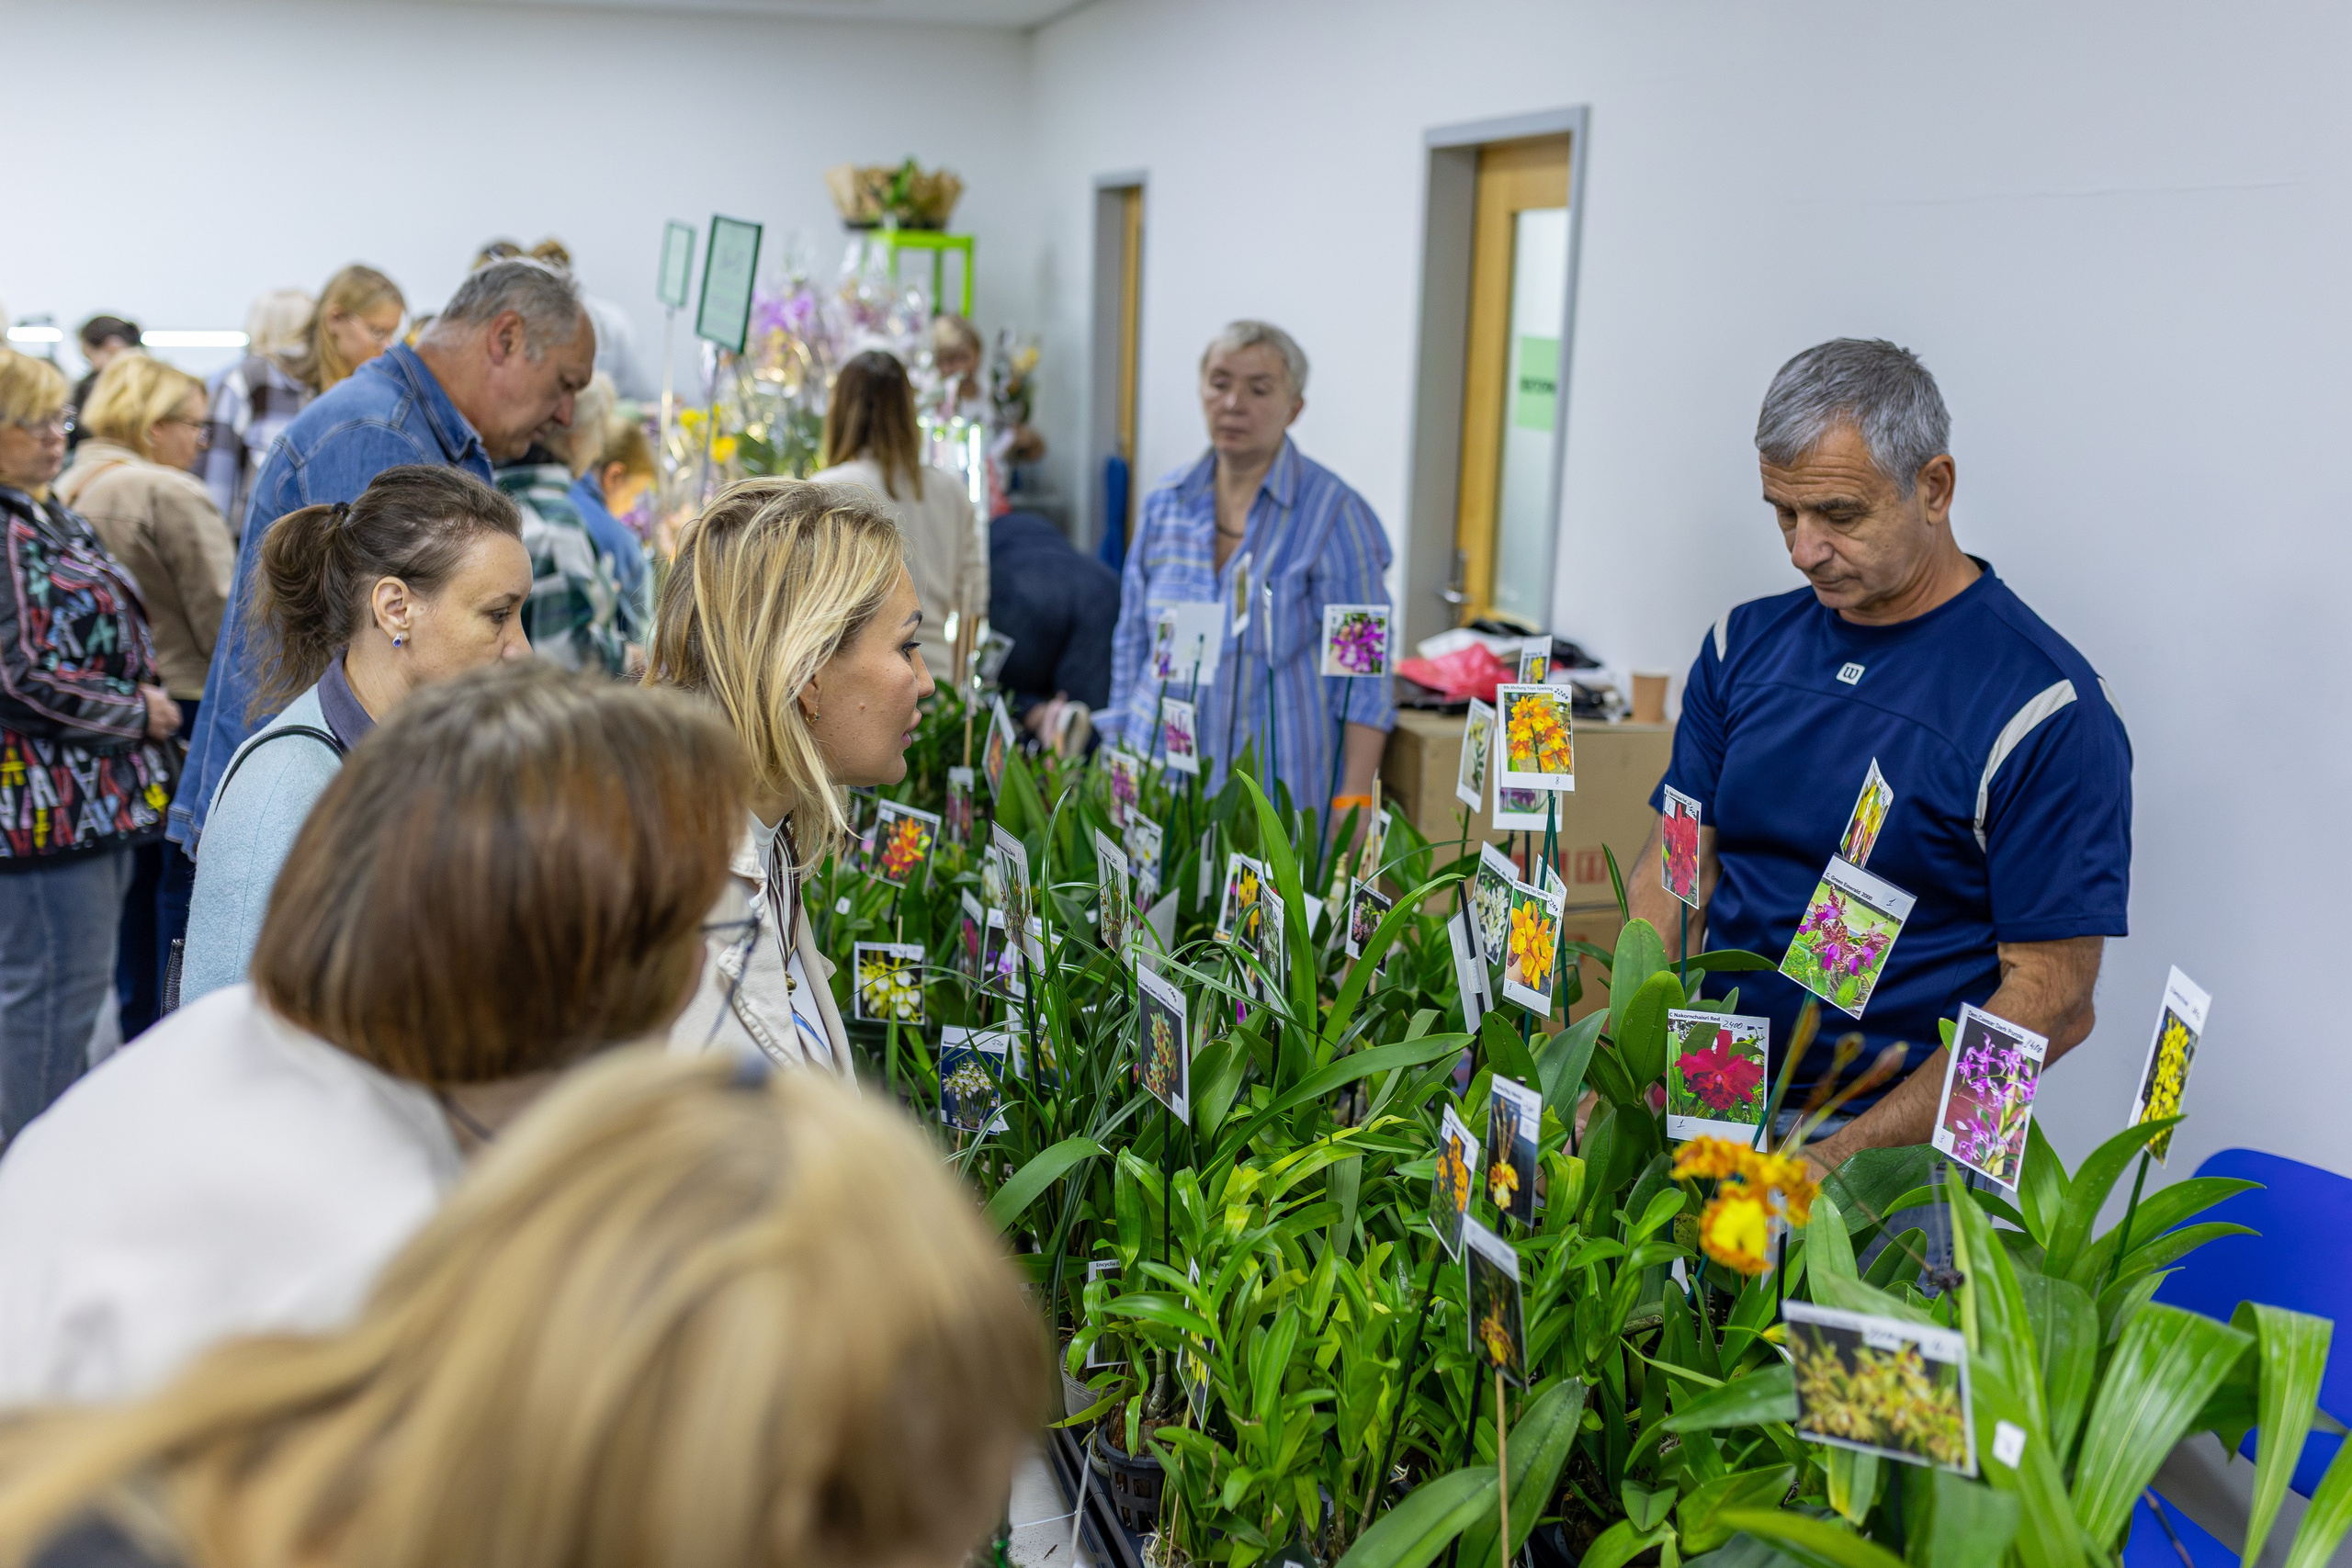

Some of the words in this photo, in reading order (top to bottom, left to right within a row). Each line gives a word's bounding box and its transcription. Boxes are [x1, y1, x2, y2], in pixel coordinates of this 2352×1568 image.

[1555, 775, 1559, 784] 8
[1830, 874, 1844, 886] Green
[1843, 882, 1860, 894] Emerald
[1861, 892, 1873, 901] 2000
[1722, 1020, 1743, 1030] 2400
[2007, 1028, 2024, 1040] Purple
[1677, 1119, 1686, 1128] 1
